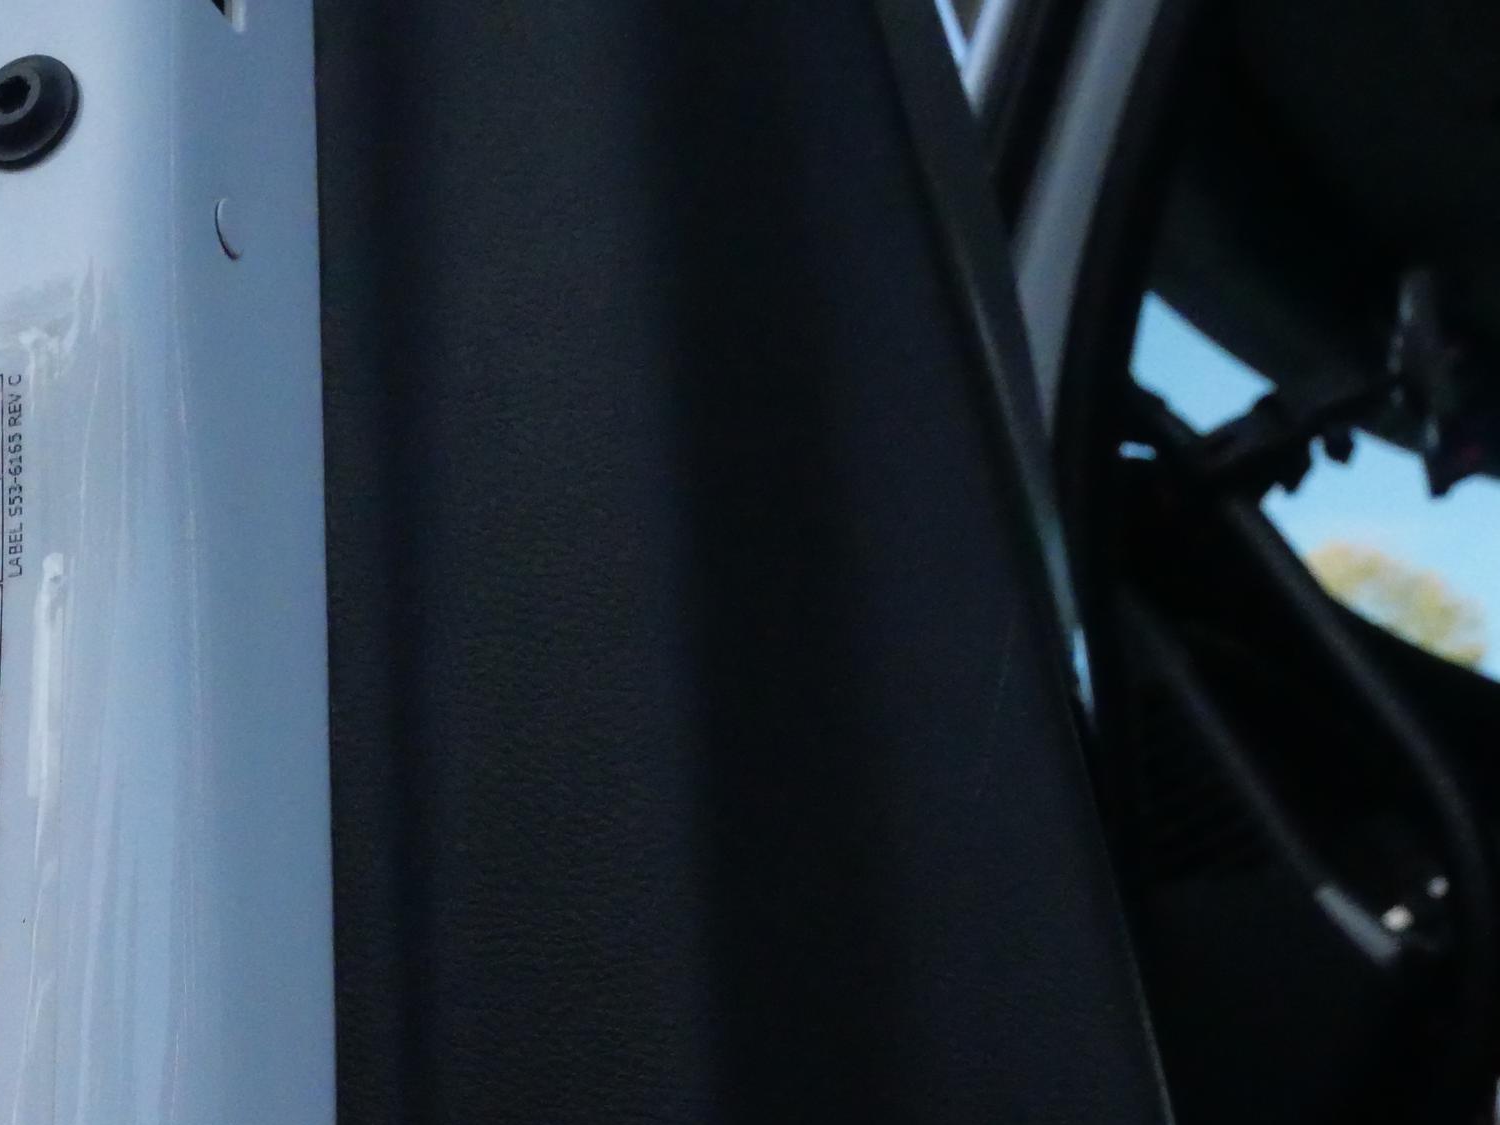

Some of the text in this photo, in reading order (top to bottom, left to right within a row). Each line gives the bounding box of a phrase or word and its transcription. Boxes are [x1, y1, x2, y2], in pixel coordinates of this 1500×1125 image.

[9, 374, 22, 386] C
[8, 393, 22, 427] REV
[8, 523, 23, 578] LABEL
